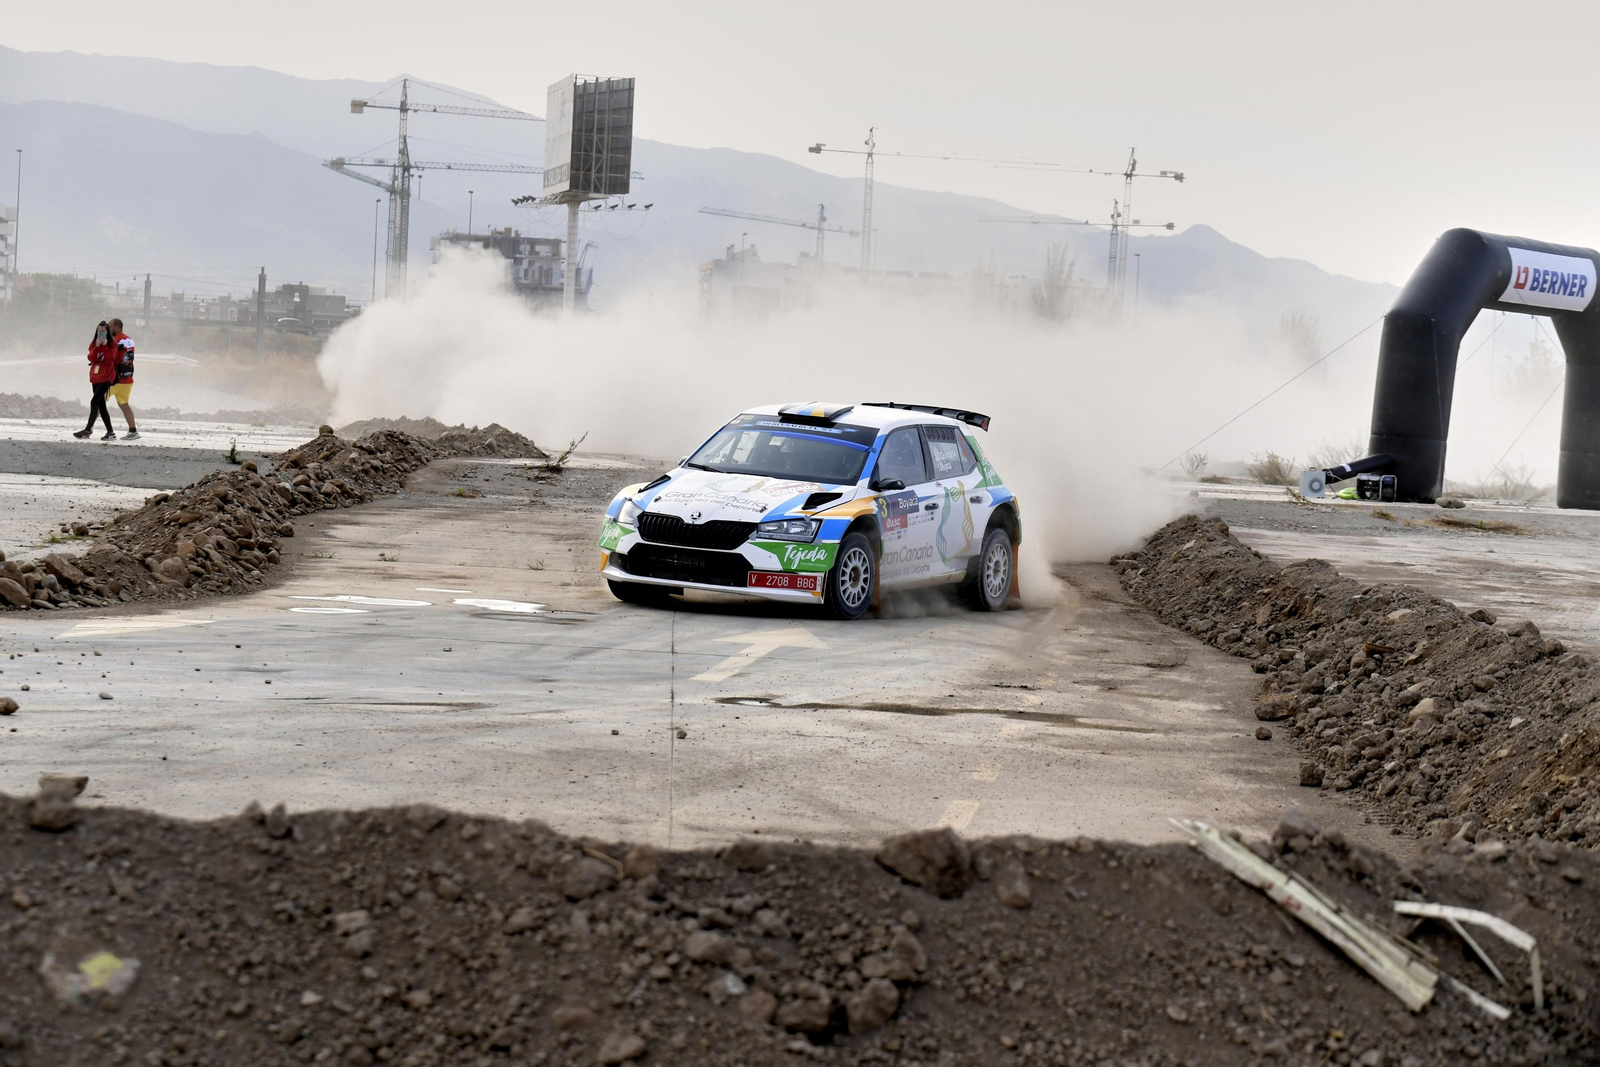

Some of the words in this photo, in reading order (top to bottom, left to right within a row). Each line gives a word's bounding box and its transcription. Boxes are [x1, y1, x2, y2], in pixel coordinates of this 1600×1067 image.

[1529, 268, 1588, 298] BERNER
[665, 490, 702, 499] Gran
[704, 492, 769, 508] Canaria
[879, 497, 888, 518] 3
[784, 544, 828, 570] Tejeda
[900, 542, 934, 564] Canaria
[751, 574, 757, 585] V
[766, 575, 789, 587] 2708
[797, 577, 815, 589] BBG
